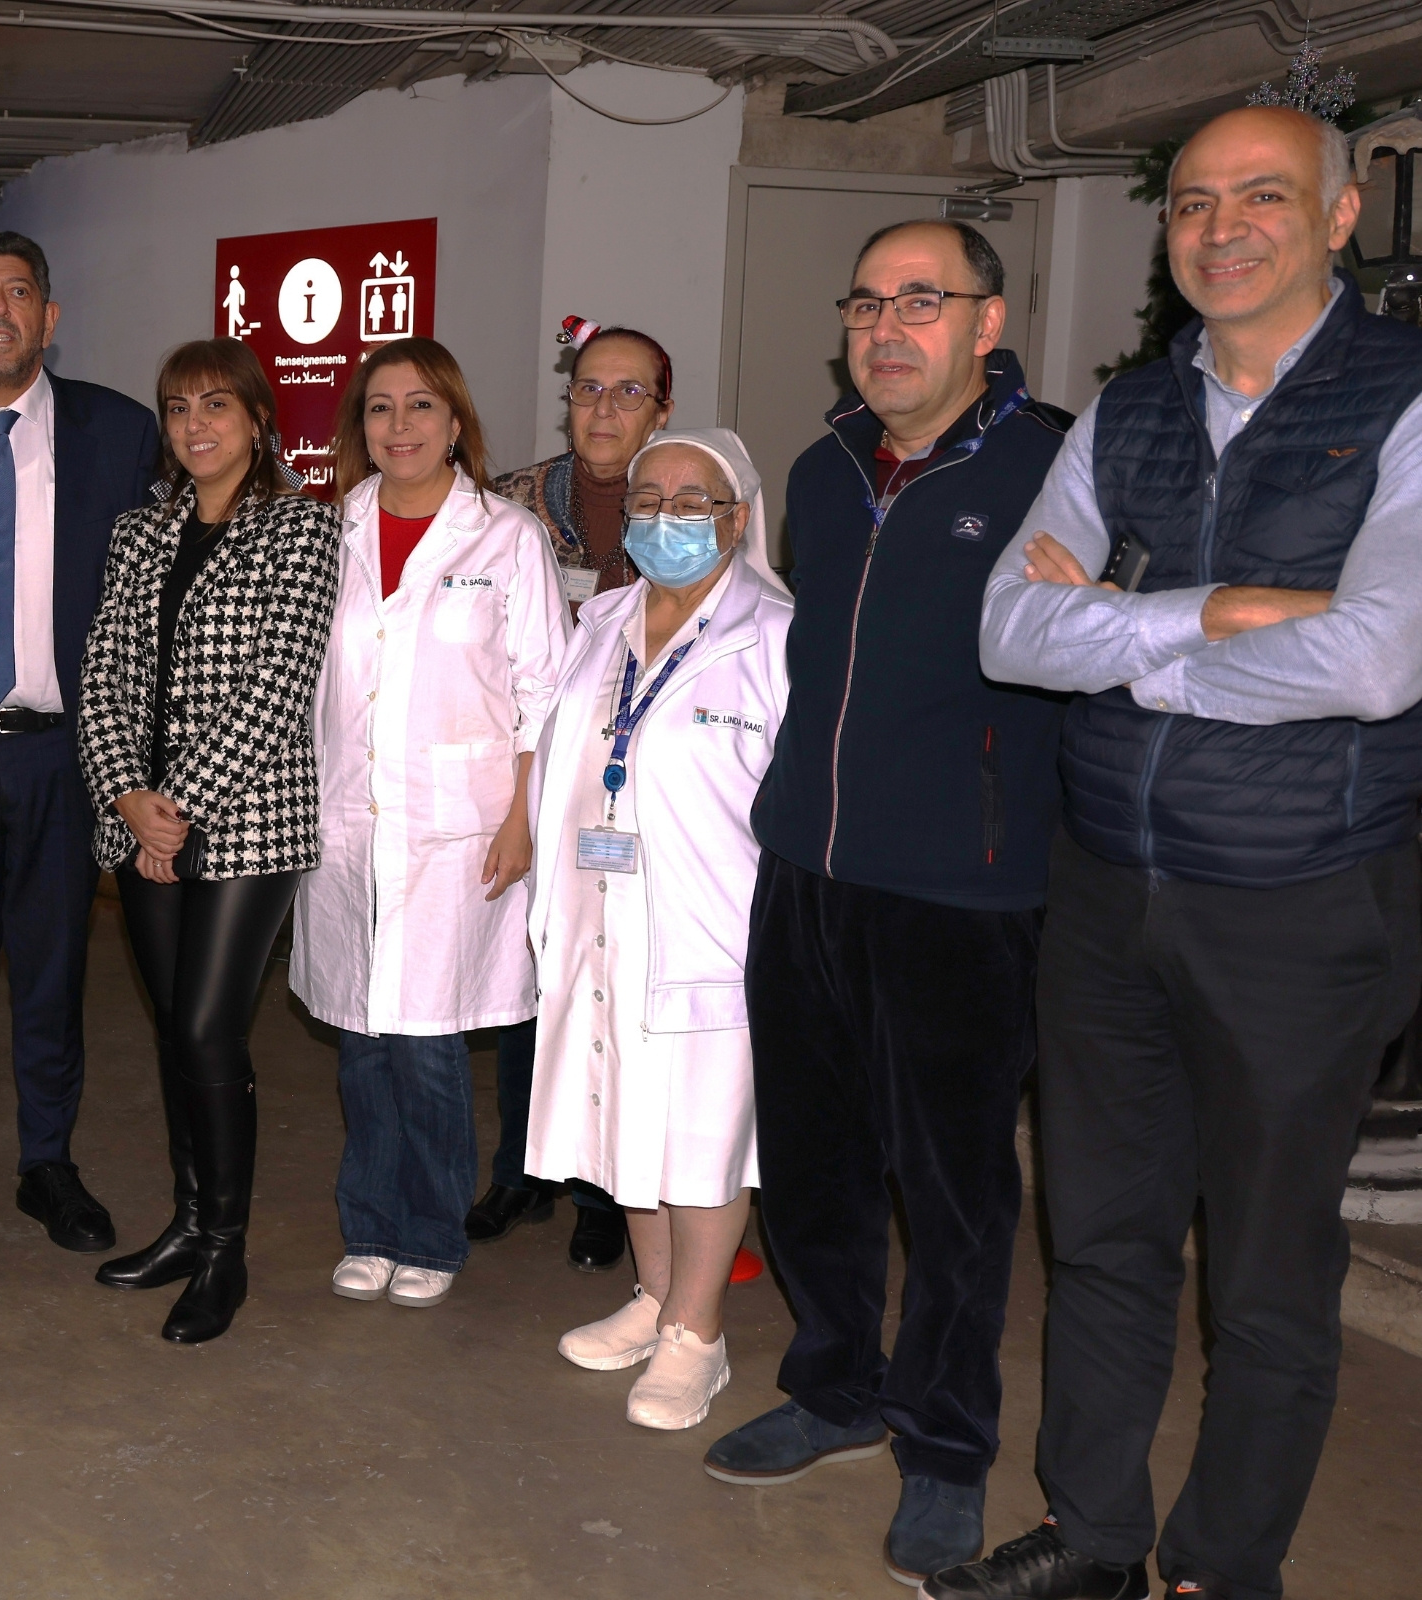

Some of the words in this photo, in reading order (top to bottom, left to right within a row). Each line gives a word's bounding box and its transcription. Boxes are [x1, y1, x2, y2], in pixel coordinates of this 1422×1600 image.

[275, 354, 346, 368] Renseignements
[279, 370, 334, 387] إستعلامات
[303, 466, 333, 485] الثان
[710, 715, 722, 723] SR.
[723, 715, 742, 726] LINDA
[744, 721, 763, 733] RAAD
